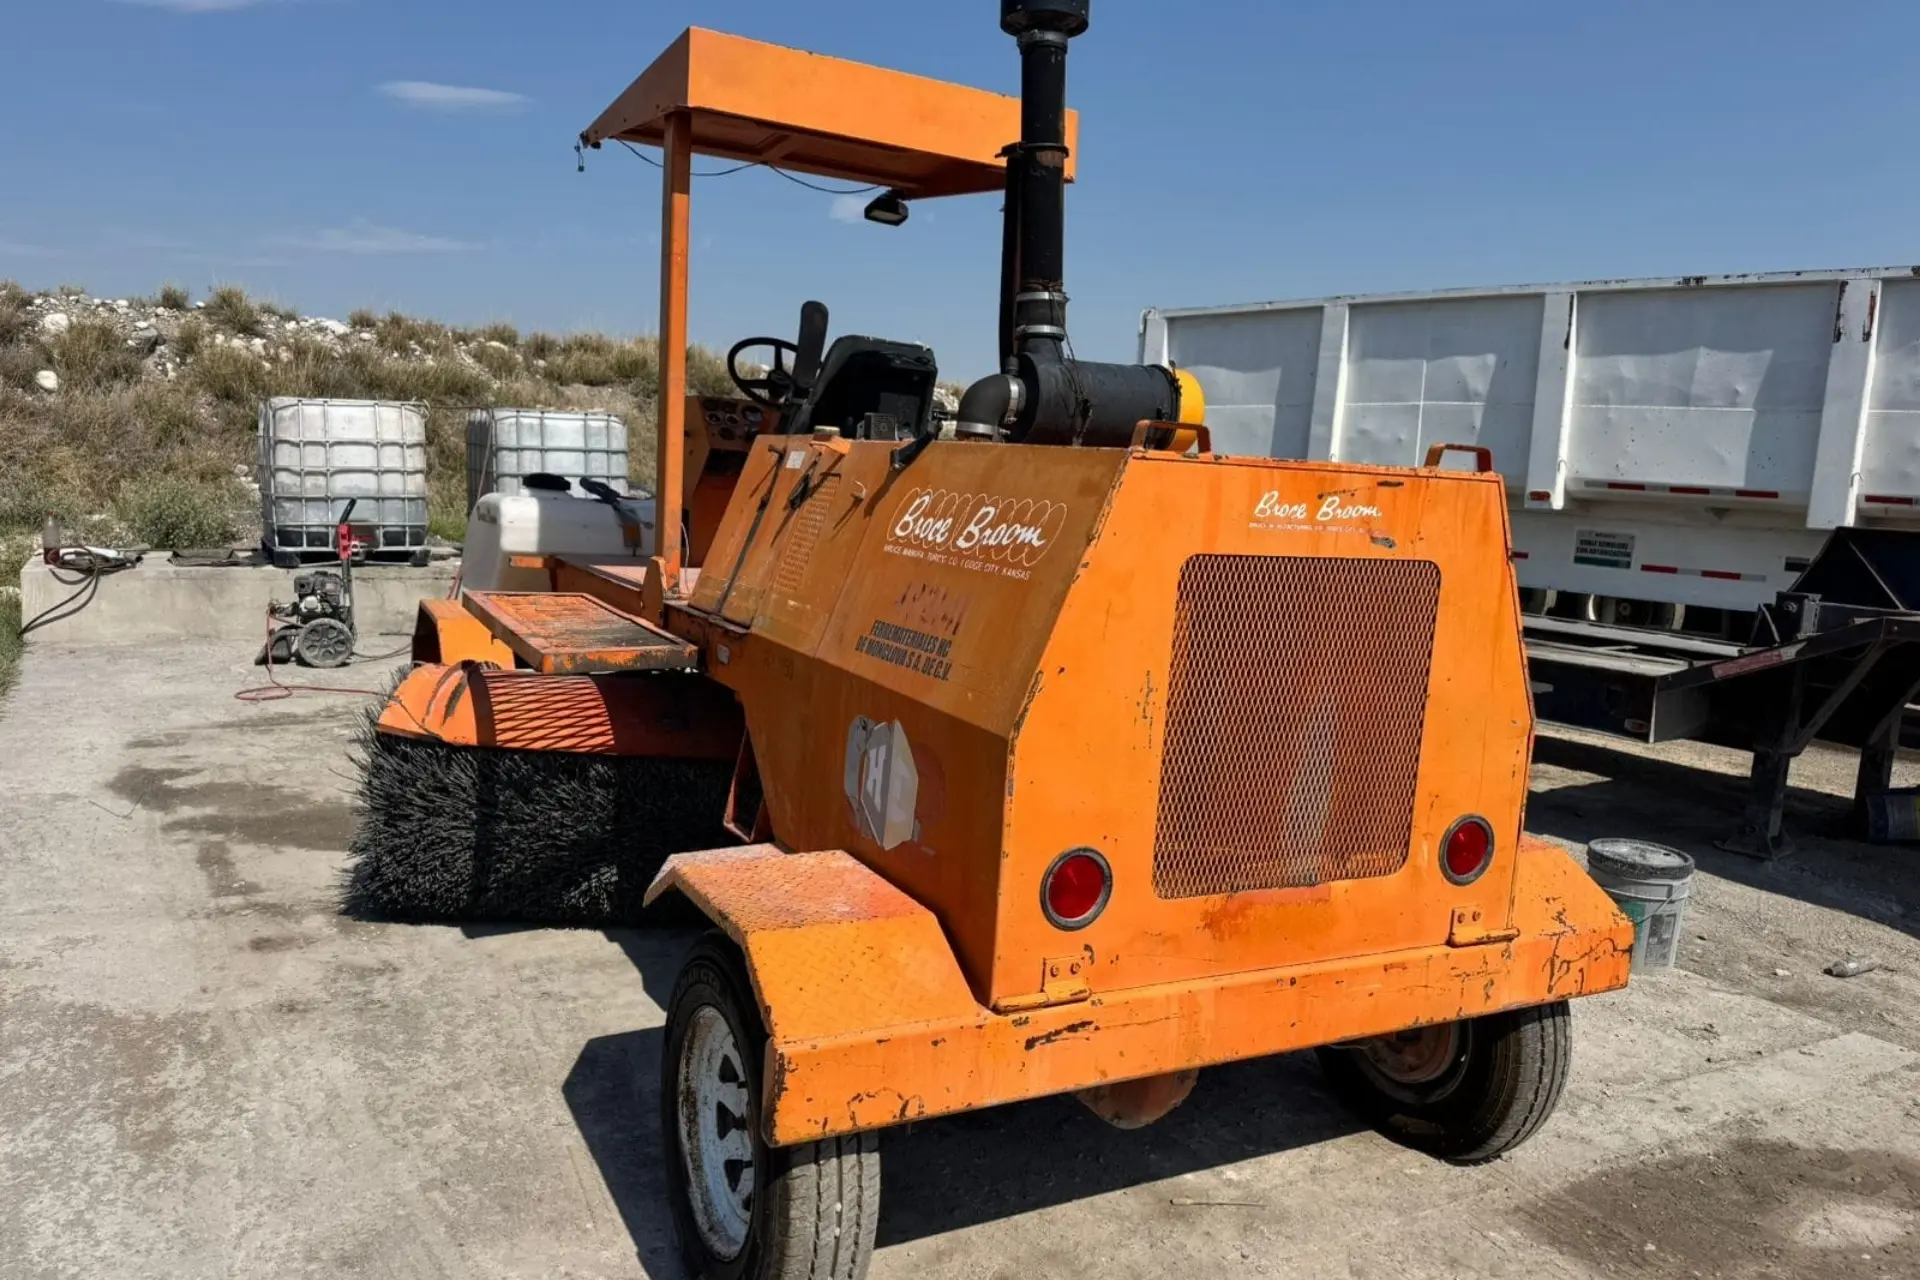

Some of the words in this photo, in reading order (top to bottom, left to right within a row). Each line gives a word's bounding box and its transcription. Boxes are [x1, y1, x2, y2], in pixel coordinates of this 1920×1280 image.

[1254, 490, 1307, 519] Broce
[1316, 496, 1382, 521] Broom
[895, 494, 953, 544] Broce
[956, 506, 1046, 549] Broom
[1002, 567, 1031, 581] KANSAS
